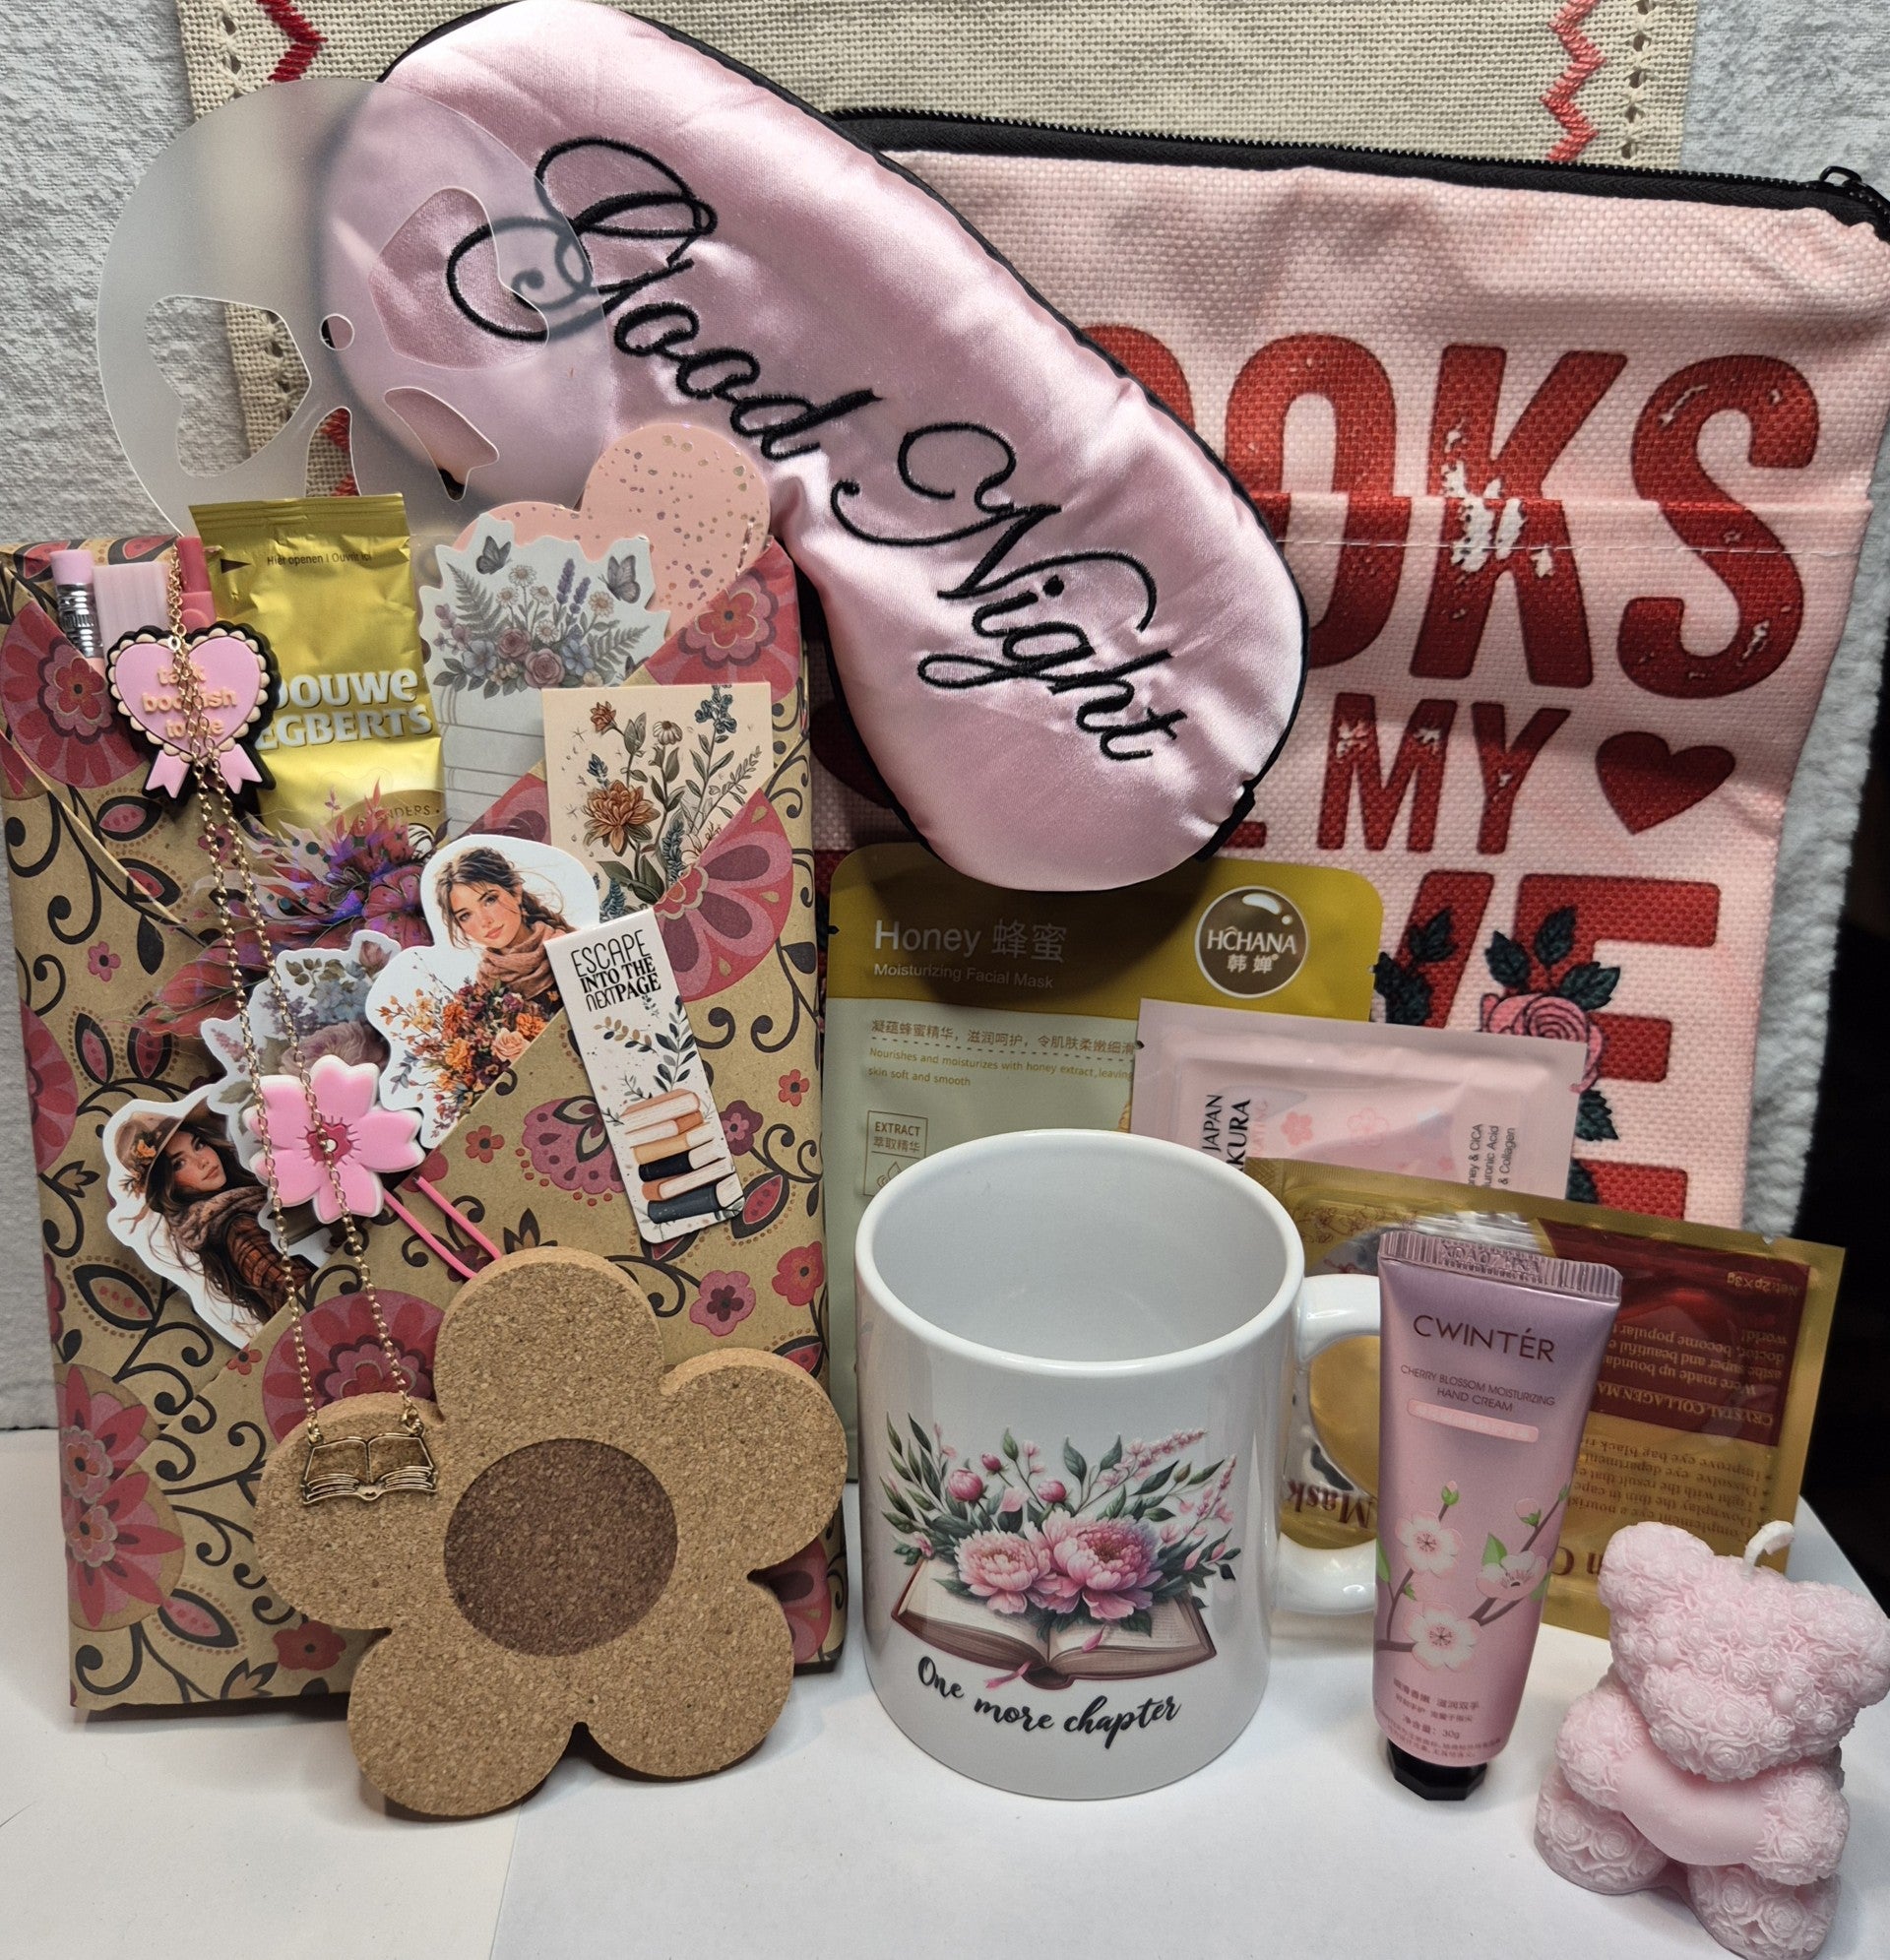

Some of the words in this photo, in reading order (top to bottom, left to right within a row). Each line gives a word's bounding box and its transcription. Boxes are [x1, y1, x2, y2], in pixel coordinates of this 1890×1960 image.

[446, 138, 882, 460] Good
[1077, 325, 1819, 699] OKS
[267, 555, 286, 566] Hier
[287, 554, 324, 566] openen
[331, 552, 359, 563] Ouvrir
[830, 421, 1186, 762] Night
[158, 665, 207, 685] tak
[142, 687, 237, 714] booish
[254, 704, 433, 751] EGBERTS
[1317, 692, 1570, 854] MY
[571, 929, 652, 979] ESCAPE
[874, 919, 981, 959] Honey
[990, 917, 1068, 964] 蜂蜜
[579, 967, 621, 994] INTO
[620, 956, 657, 981] THE
[873, 963, 962, 982] Moisturizing
[966, 967, 1010, 985] Facial
[1014, 971, 1054, 989] Mask
[869, 1047, 917, 1062] Nourishes
[920, 1053, 939, 1064] and
[942, 1055, 999, 1070] moisturizes
[1001, 1060, 1023, 1072] with
[1026, 1062, 1057, 1075] honey
[867, 1065, 888, 1078] skin
[890, 1069, 910, 1080] soft
[912, 1072, 930, 1082] and
[933, 1074, 971, 1087] smooth
[875, 1121, 921, 1137] EXTRACT
[1202, 1094, 1224, 1153] JAPAN
[1227, 1099, 1251, 1172] KURA
[1470, 1123, 1483, 1151] CICA
[1486, 1125, 1499, 1151] Acid
[1499, 1127, 1517, 1174] Collagen
[1413, 1314, 1555, 1362] CWINTÉR
[1621, 1324, 1675, 1344] popular
[1677, 1335, 1732, 1359] become
[1604, 1355, 1656, 1377] bounda
[1620, 1341, 1678, 1364] beautiful
[1680, 1353, 1706, 1368] and
[1659, 1362, 1675, 1377] up
[1679, 1369, 1717, 1387] made
[1400, 1364, 1436, 1381] CHERRY
[1439, 1374, 1486, 1393] BLOSSOM
[1487, 1384, 1556, 1407] MOISTURIZING
[1597, 1382, 1620, 1398] MA
[1437, 1387, 1470, 1403] HAND
[1472, 1394, 1513, 1412] CREAM
[1623, 1388, 1705, 1416] COLLAGEN
[1711, 1404, 1773, 1426] CRYSTAL
[1601, 1439, 1638, 1457] black
[1287, 1478, 1374, 1530] Mask
[917, 1655, 965, 1700] One
[974, 1696, 1055, 1733] more
[1063, 1694, 1183, 1749] chapter
